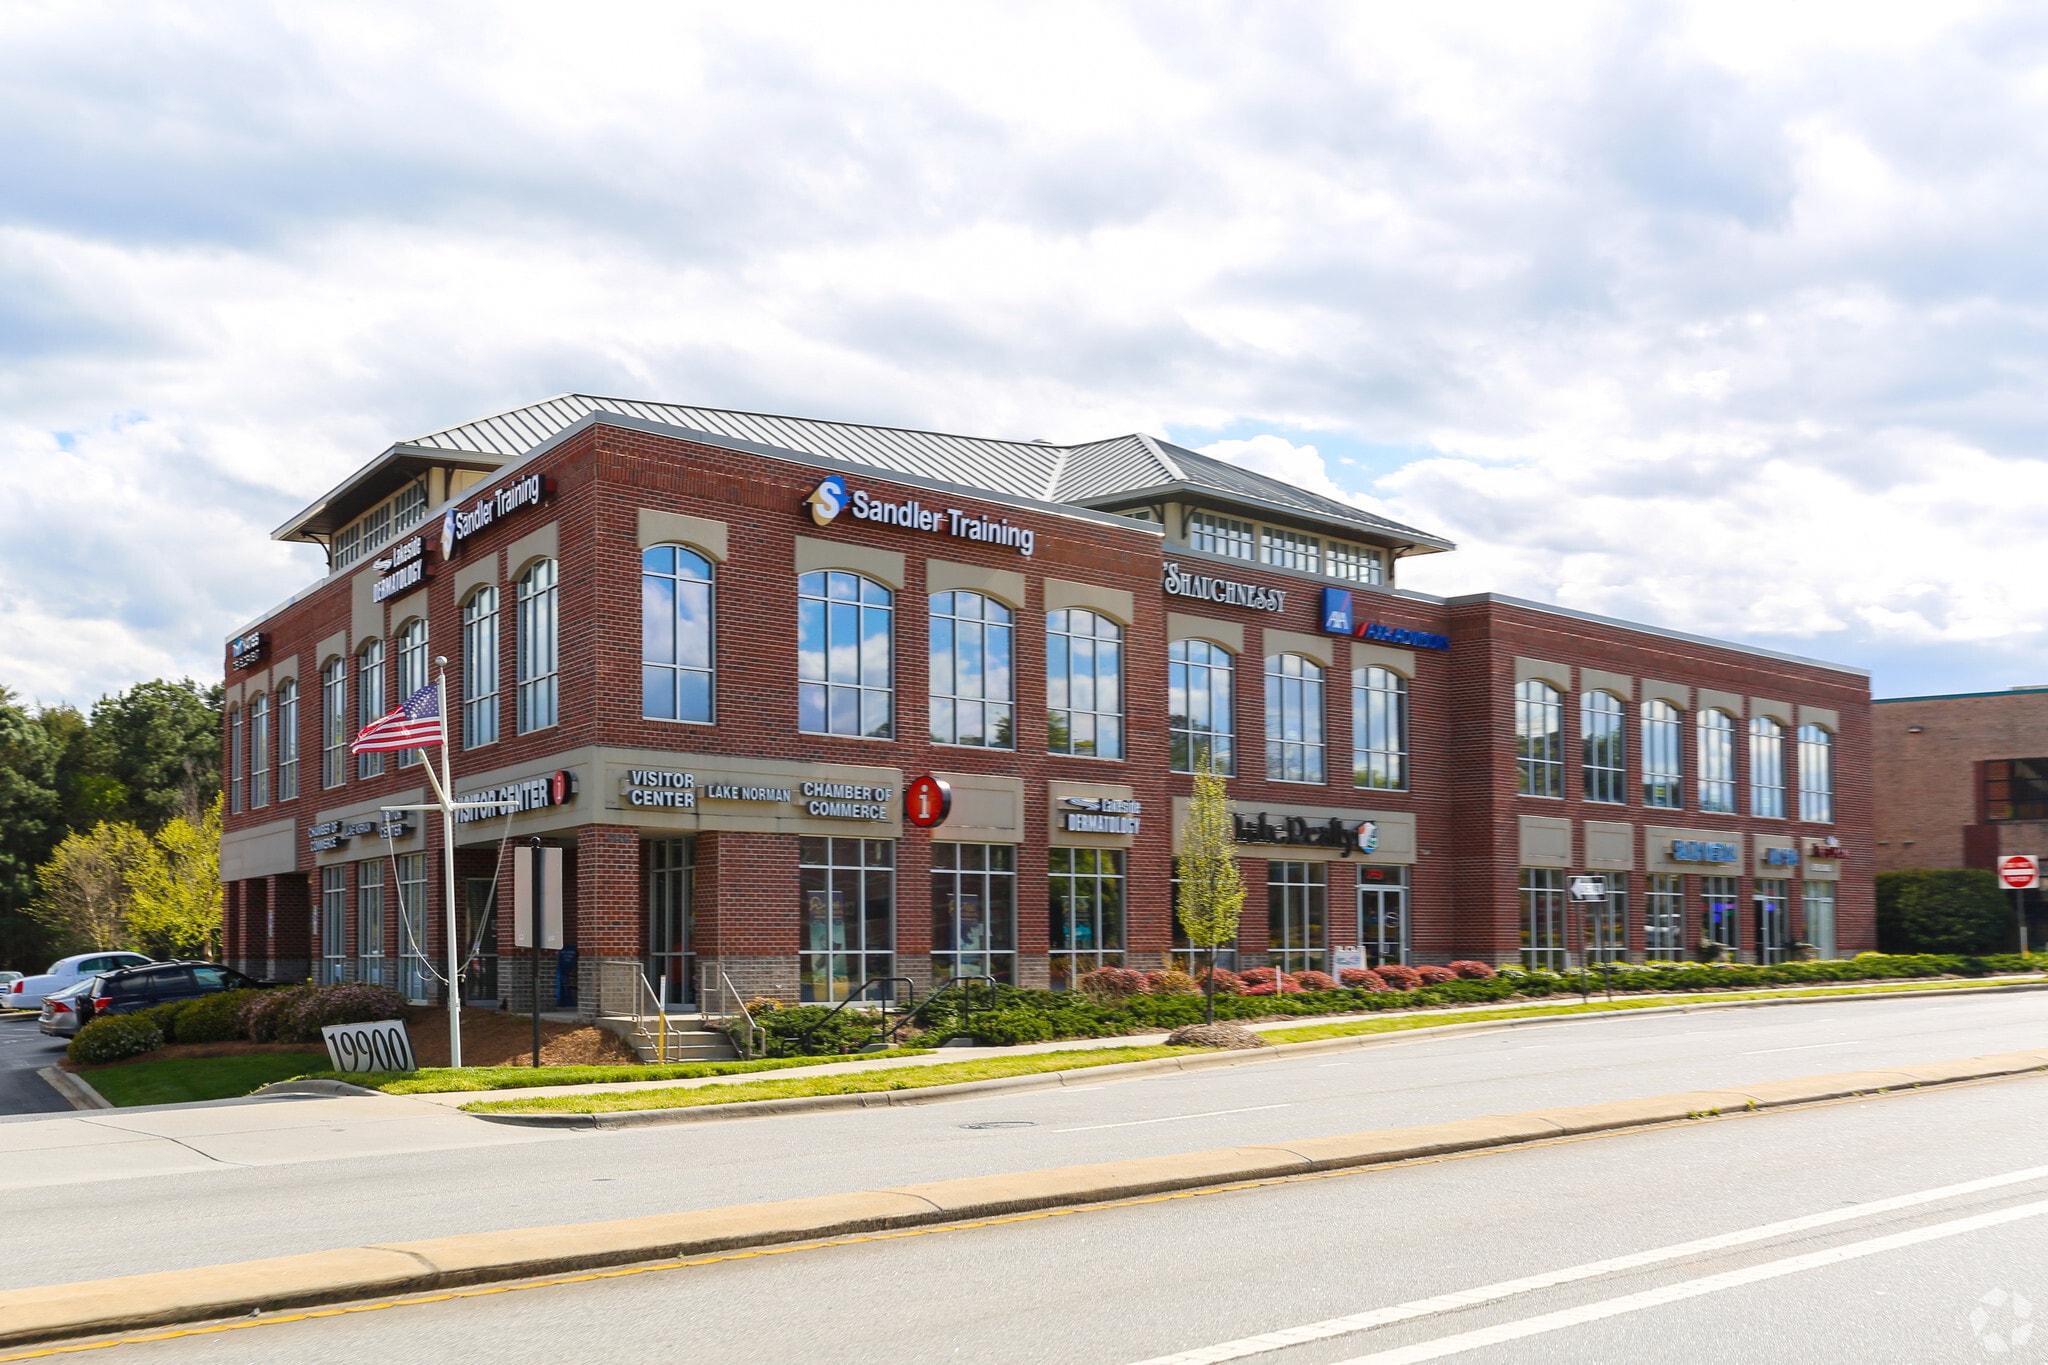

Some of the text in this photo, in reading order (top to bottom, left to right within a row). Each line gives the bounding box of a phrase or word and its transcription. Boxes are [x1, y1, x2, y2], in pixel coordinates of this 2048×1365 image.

[455, 499, 494, 540] Sandler
[495, 474, 540, 517] Training
[852, 490, 943, 532] Sandler
[947, 508, 1035, 556] Training
[392, 535, 422, 568] Lakeside
[373, 558, 424, 604] DERMATOLOGY
[1325, 610, 1350, 630] AXA
[630, 770, 695, 788] VISITOR
[454, 789, 496, 824] VISITOR
[498, 778, 549, 816] CENTER
[630, 789, 695, 808] CENTER
[708, 785, 791, 803] LAKE NORMAN
[803, 781, 893, 802] CHAMBER OF
[808, 800, 887, 820] COMMERCE
[1102, 798, 1141, 814] Lakeside
[1067, 813, 1140, 835] DERMATOLOGY
[328, 1027, 408, 1072] 19900
